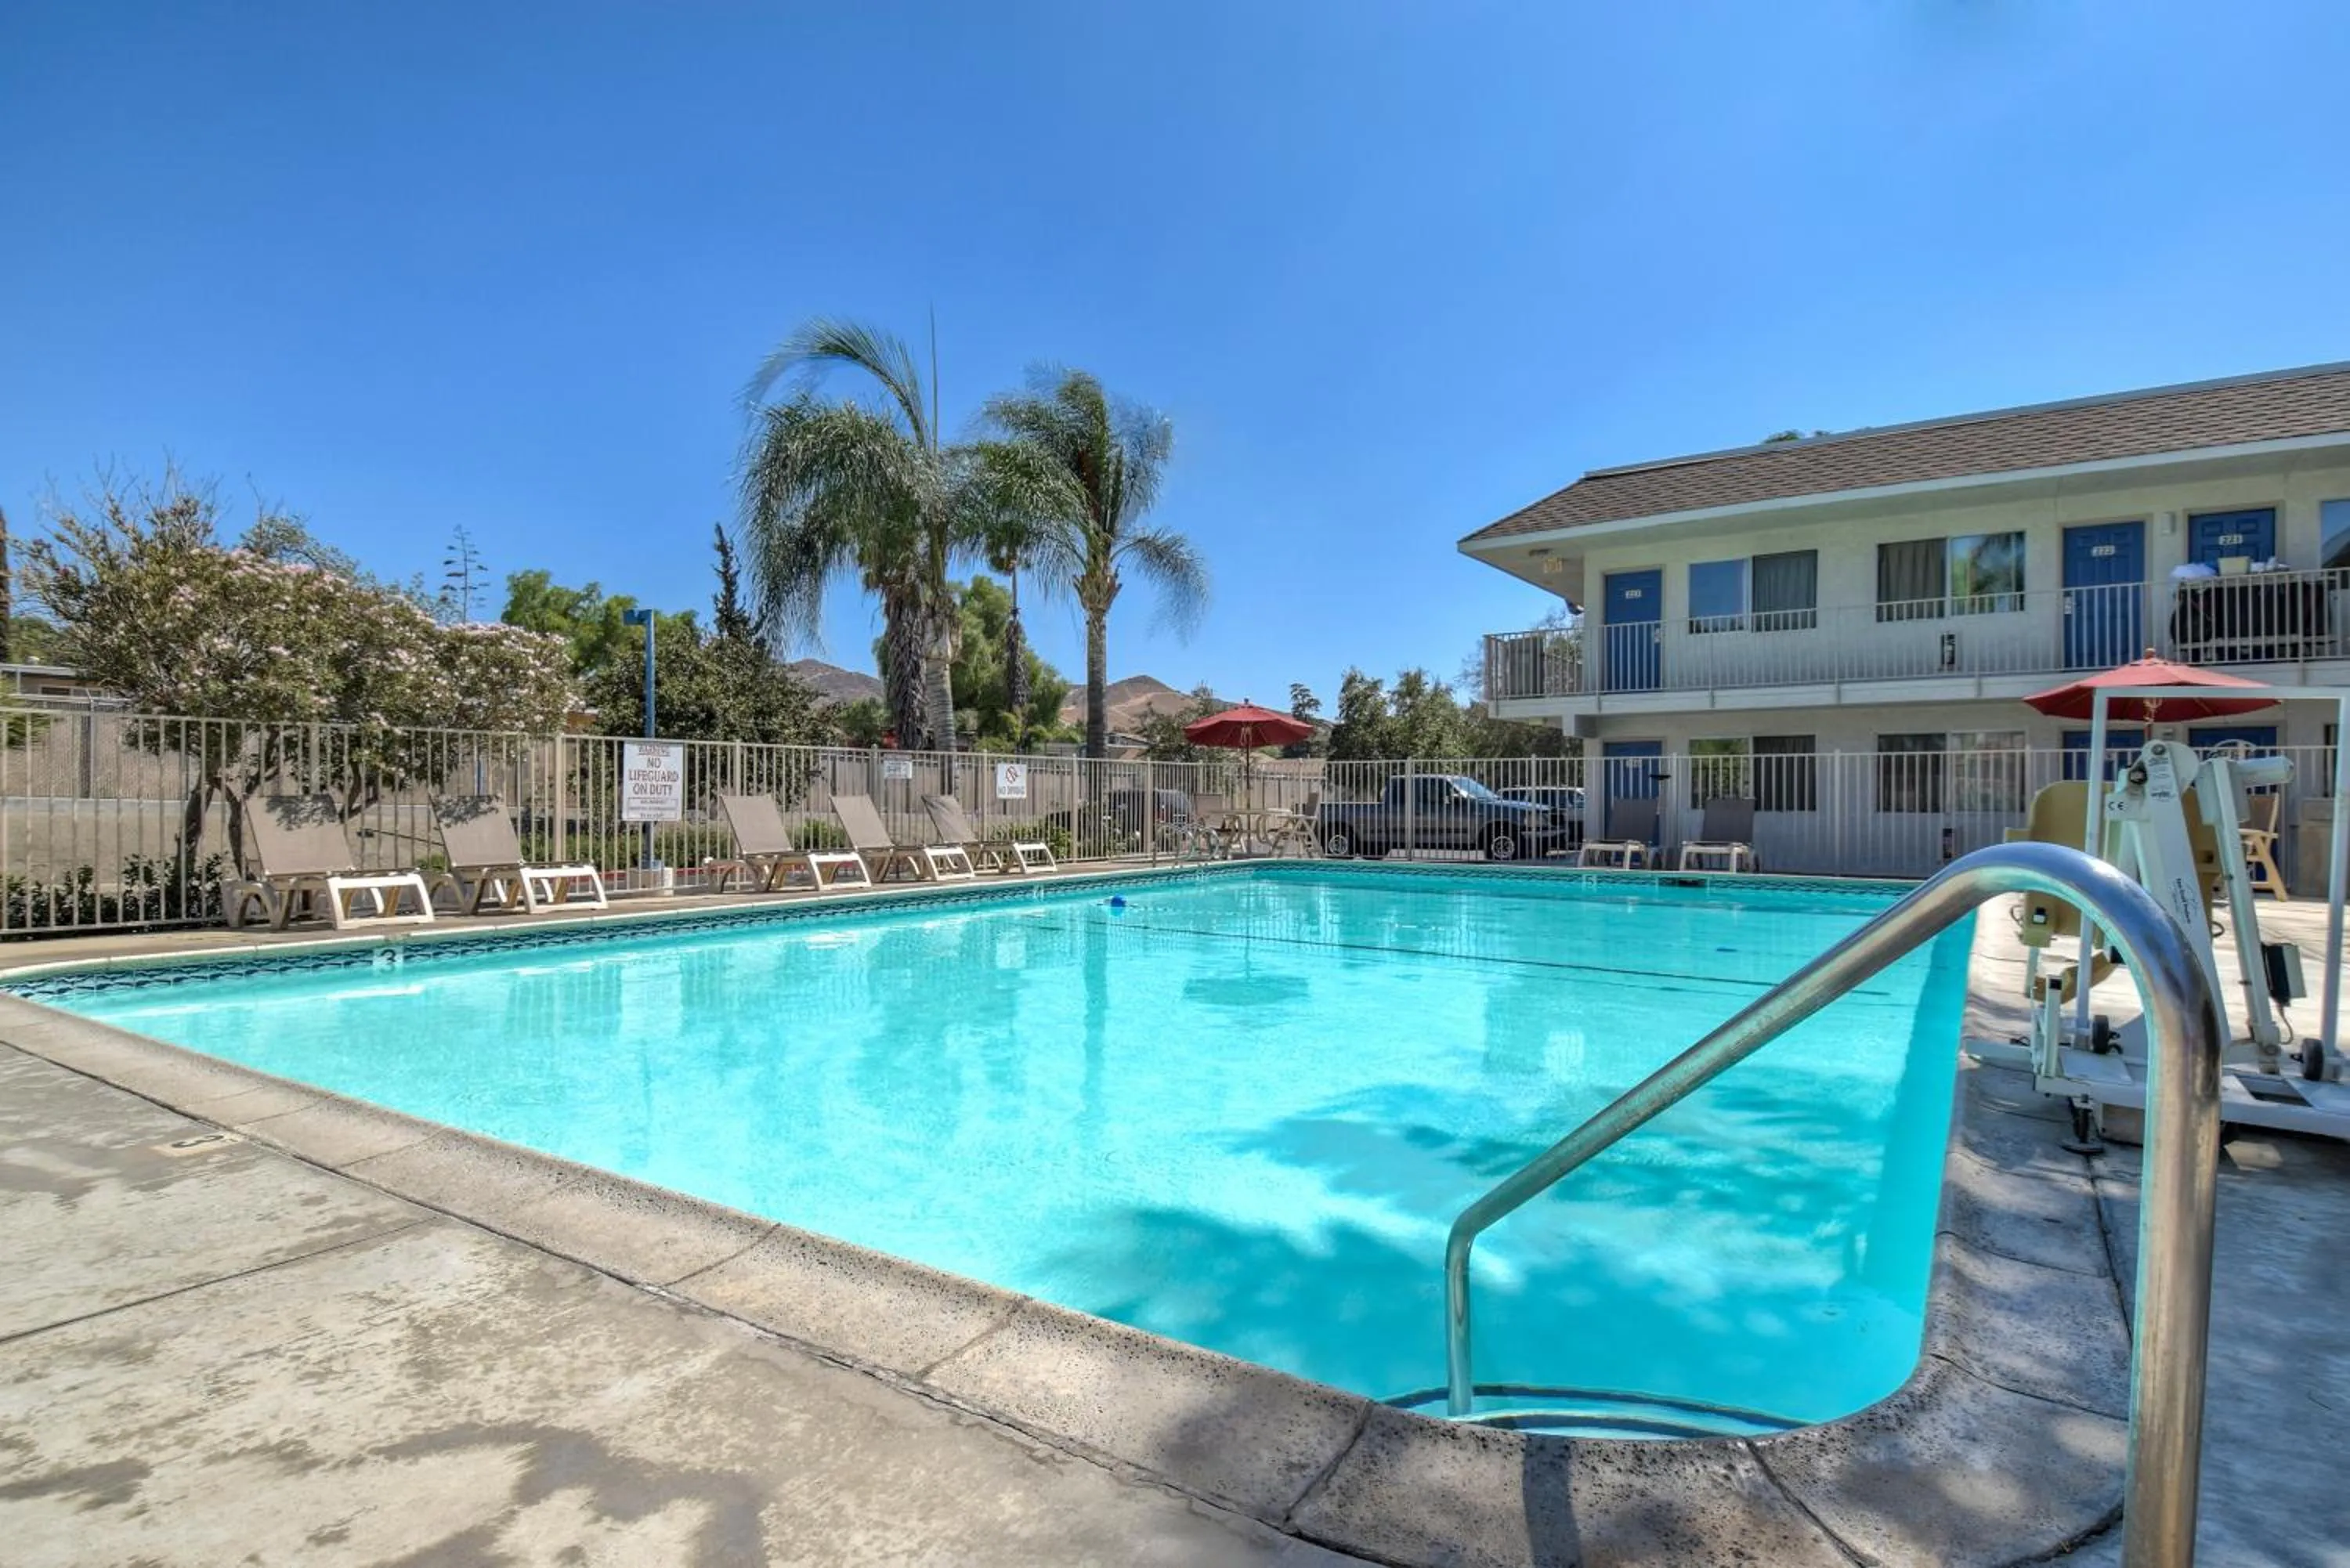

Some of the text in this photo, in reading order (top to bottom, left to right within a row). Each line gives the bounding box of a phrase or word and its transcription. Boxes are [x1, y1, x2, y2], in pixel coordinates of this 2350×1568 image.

[647, 757, 662, 768] NO
[628, 769, 679, 782] LIFEGUARD
[633, 783, 673, 796] ON DUTY
[2108, 801, 2124, 811] CE
